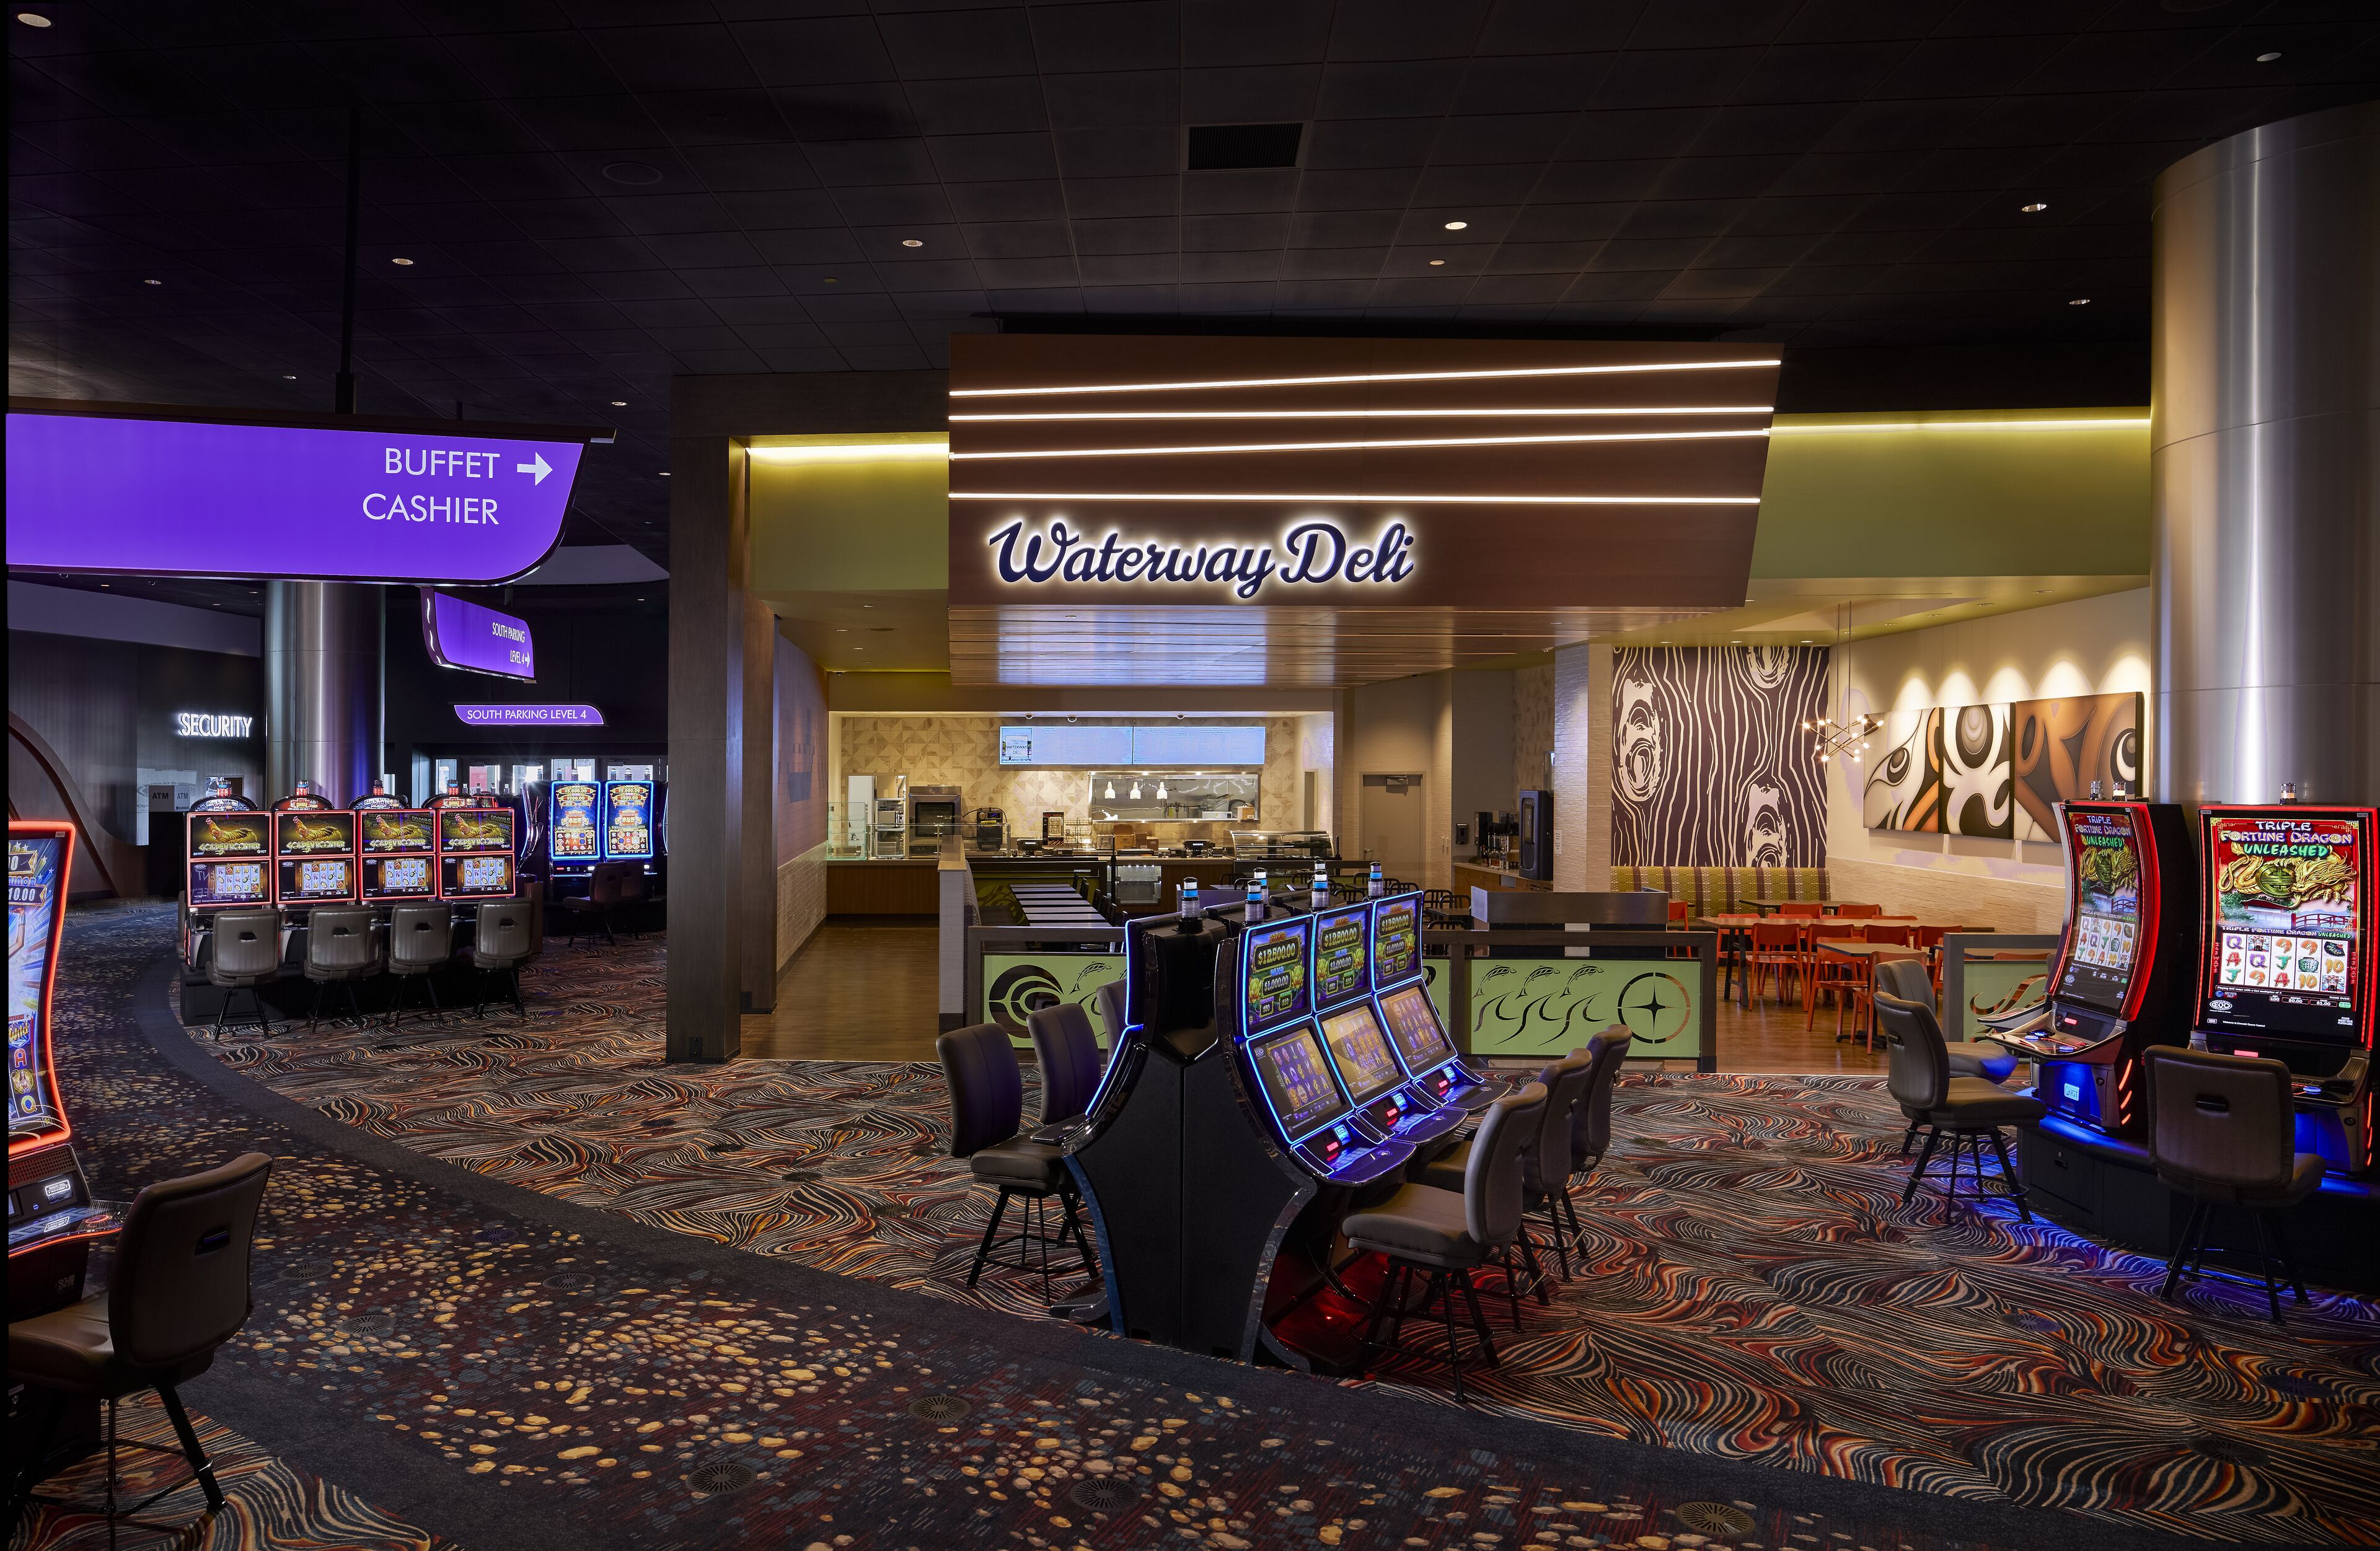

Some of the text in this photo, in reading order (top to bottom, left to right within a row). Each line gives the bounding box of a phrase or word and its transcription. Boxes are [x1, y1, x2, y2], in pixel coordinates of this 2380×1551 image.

[385, 448, 500, 478] BUFFET
[362, 493, 500, 525] CASHIER
[989, 521, 1414, 599] Waterway Deli
[492, 622, 525, 643] SOUTH PARKING
[510, 650, 524, 664] LEVEL 4
[467, 710, 587, 719] SOUTH PARKING LEVEL 4
[178, 713, 253, 737] SECURITY
[2087, 815, 2112, 825] TRIPLE
[2255, 820, 2312, 831] TRIPLE
[2074, 824, 2131, 837] FORTUNE DRAGON
[2220, 830, 2353, 844] FORTUNE DRAGON
[198, 843, 229, 851] GOLDEN
[315, 840, 346, 848] ROOSTER
[398, 838, 426, 846] ROOSTER
[448, 838, 476, 846] GOLDEN
[2086, 836, 2124, 848] UNLEASHED
[2243, 843, 2329, 857] UNLEASHED
[1324, 927, 1357, 947] $12,500.00
[1258, 942, 1295, 965] $12,500.00
[1330, 956, 1351, 972] $1,000.00
[1264, 975, 1289, 991] $1,000.00
